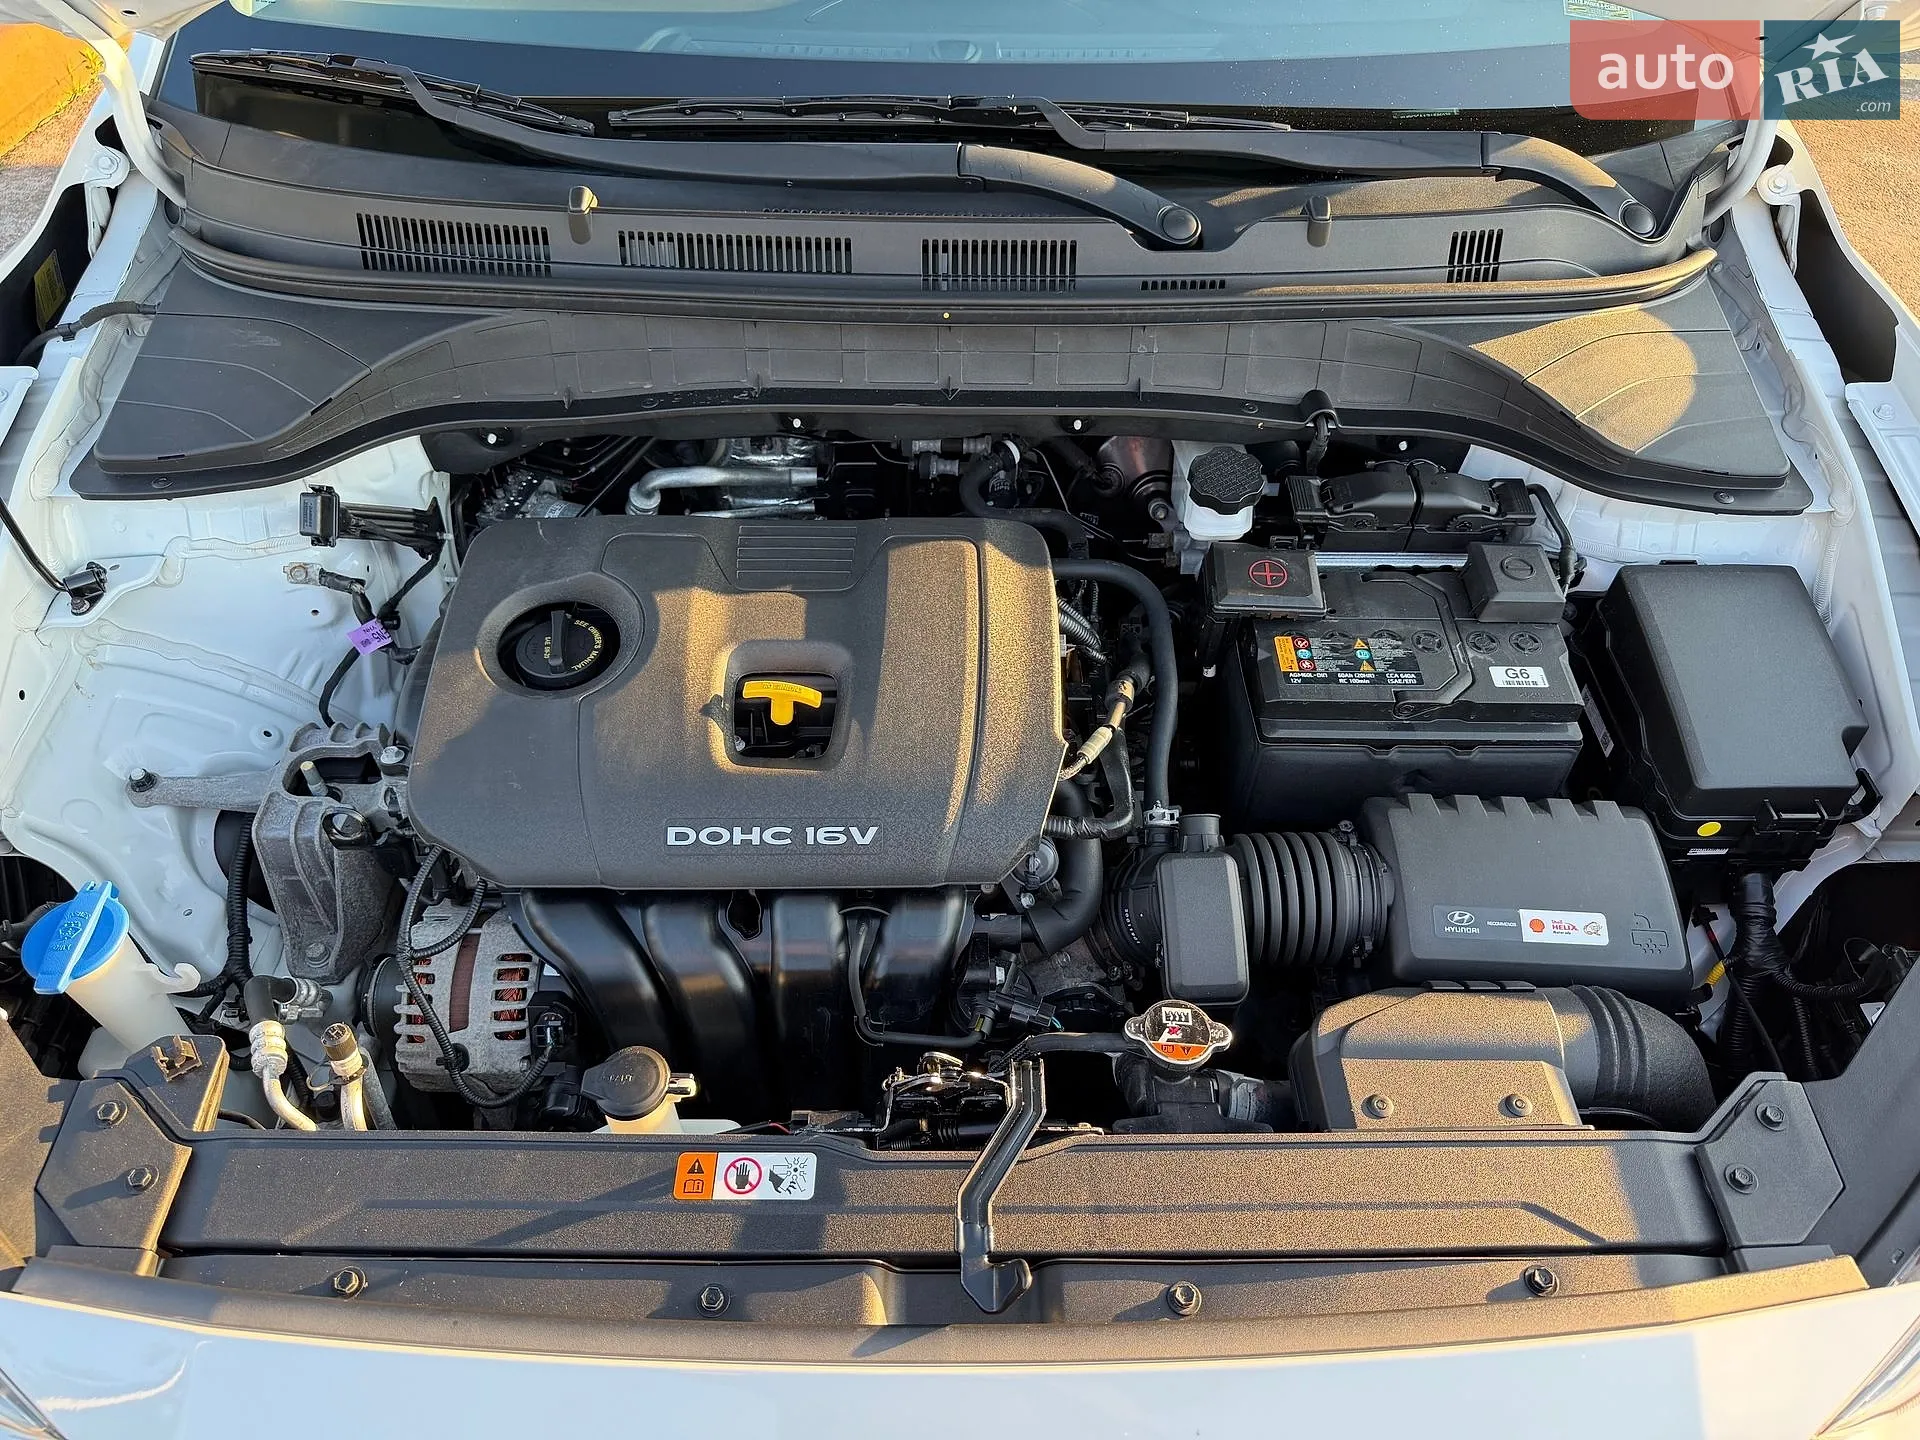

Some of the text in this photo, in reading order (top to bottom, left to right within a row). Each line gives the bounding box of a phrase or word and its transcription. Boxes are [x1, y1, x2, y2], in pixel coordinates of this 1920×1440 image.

[571, 650, 599, 670] MANUAL
[1505, 667, 1530, 679] G6
[666, 826, 879, 846] DOHC 16V
[1444, 926, 1480, 934] HYUNDAI
[1552, 923, 1579, 931] HELIX
